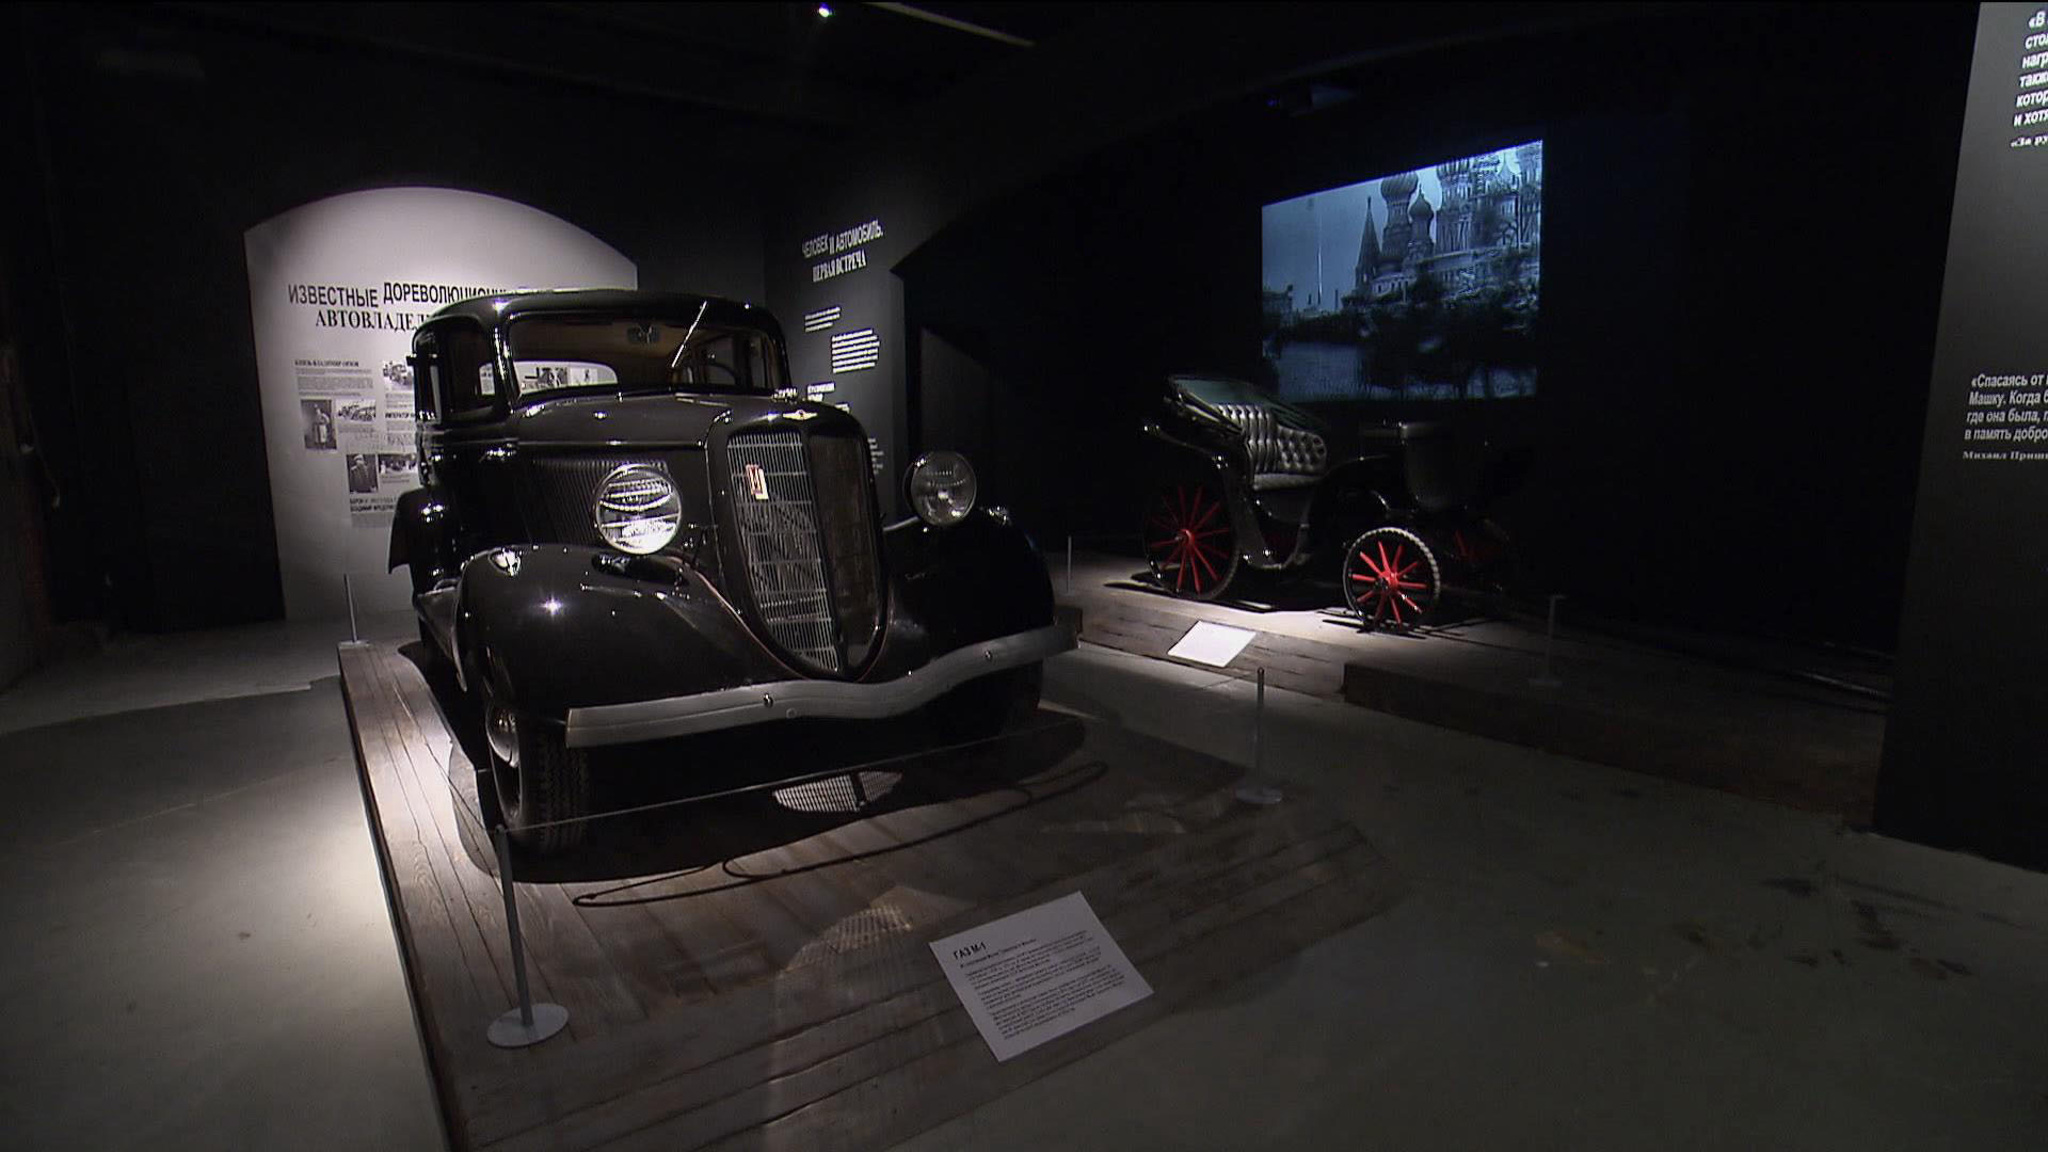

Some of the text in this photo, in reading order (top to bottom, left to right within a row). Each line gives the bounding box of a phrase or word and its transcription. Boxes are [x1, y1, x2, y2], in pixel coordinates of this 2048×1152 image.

[288, 284, 379, 308] ИЗВЕСТНЫЕ
[1971, 374, 2028, 388] «Спасаясь
[2030, 374, 2044, 386] от
[1969, 392, 2006, 408] Машку.
[2009, 390, 2041, 406] Когда
[1966, 411, 1984, 425] где
[1986, 411, 2005, 422] она
[2007, 408, 2040, 424] была,
[1965, 430, 1972, 440] в
[1973, 428, 2012, 440] память
[1963, 451, 2007, 460] Михаил
